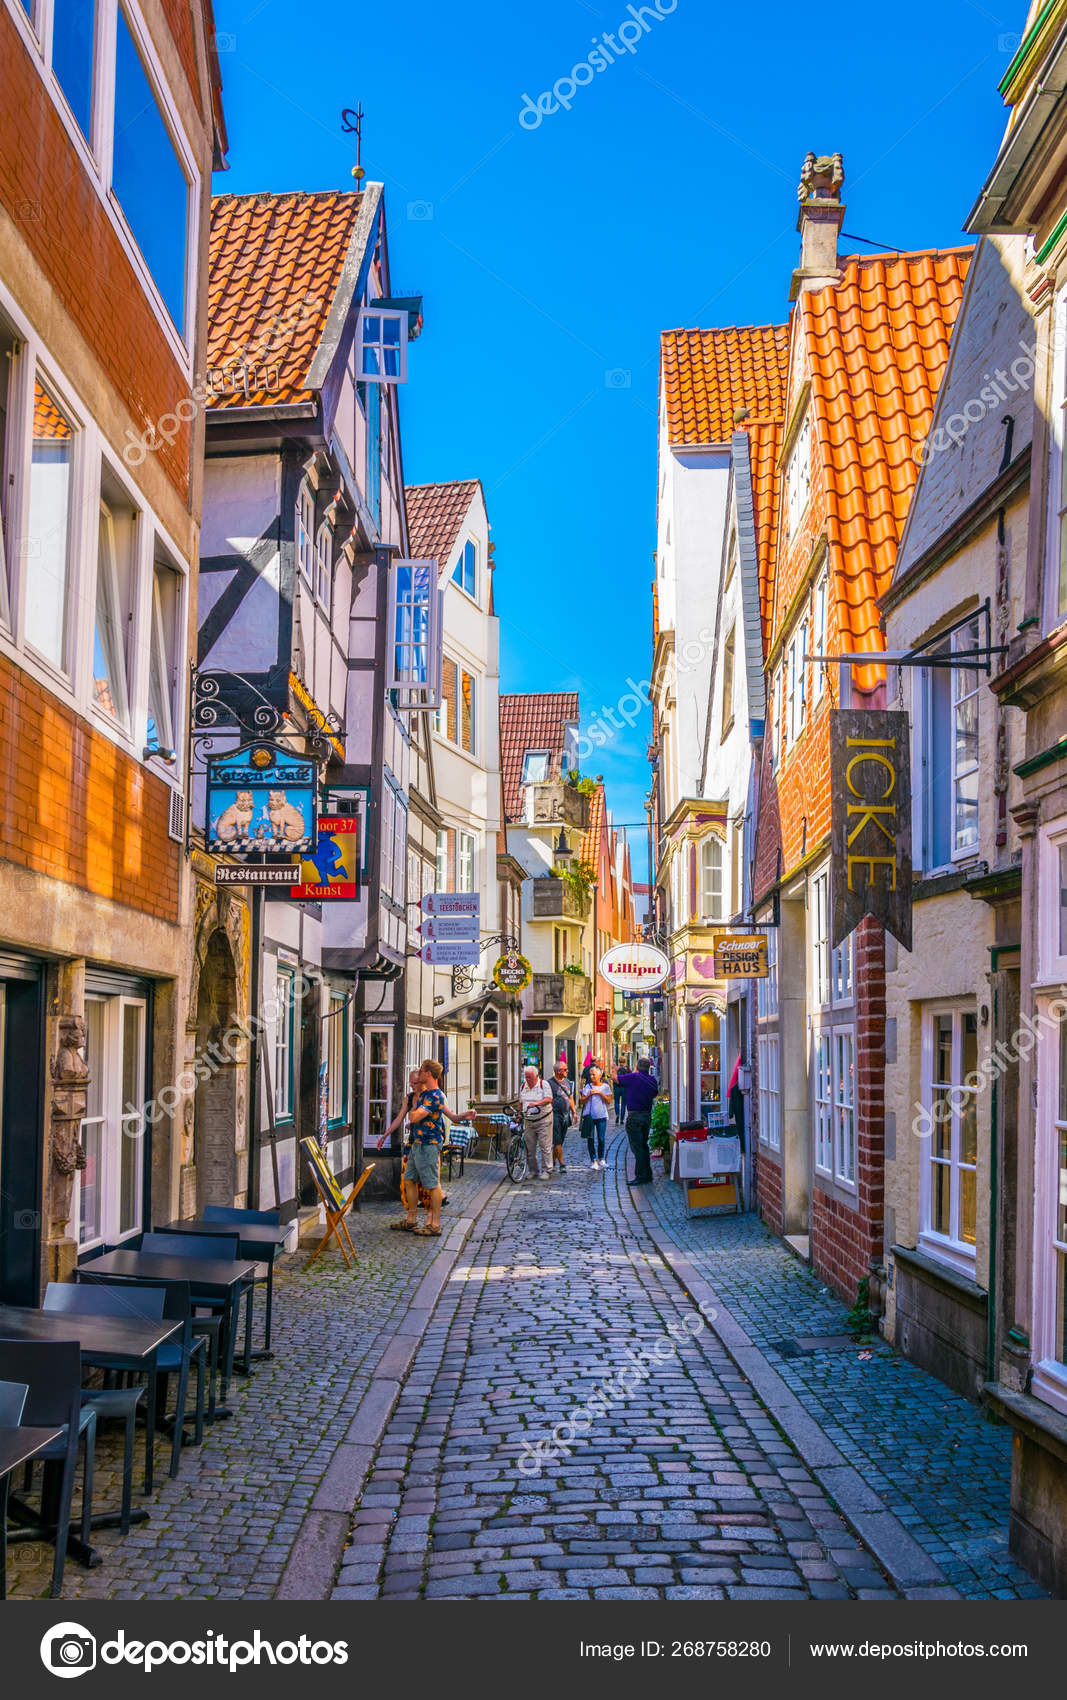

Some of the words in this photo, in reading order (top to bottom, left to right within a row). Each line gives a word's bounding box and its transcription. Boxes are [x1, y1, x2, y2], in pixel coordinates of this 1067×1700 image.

[846, 736, 896, 892] ICKE
[341, 820, 354, 832] 37
[217, 868, 299, 881] Restaurant
[305, 884, 342, 896] Kunst
[717, 940, 765, 952] Schnoor
[723, 952, 760, 962] DESIGN
[607, 963, 663, 977] Lilliput
[723, 962, 760, 974] HAUS
